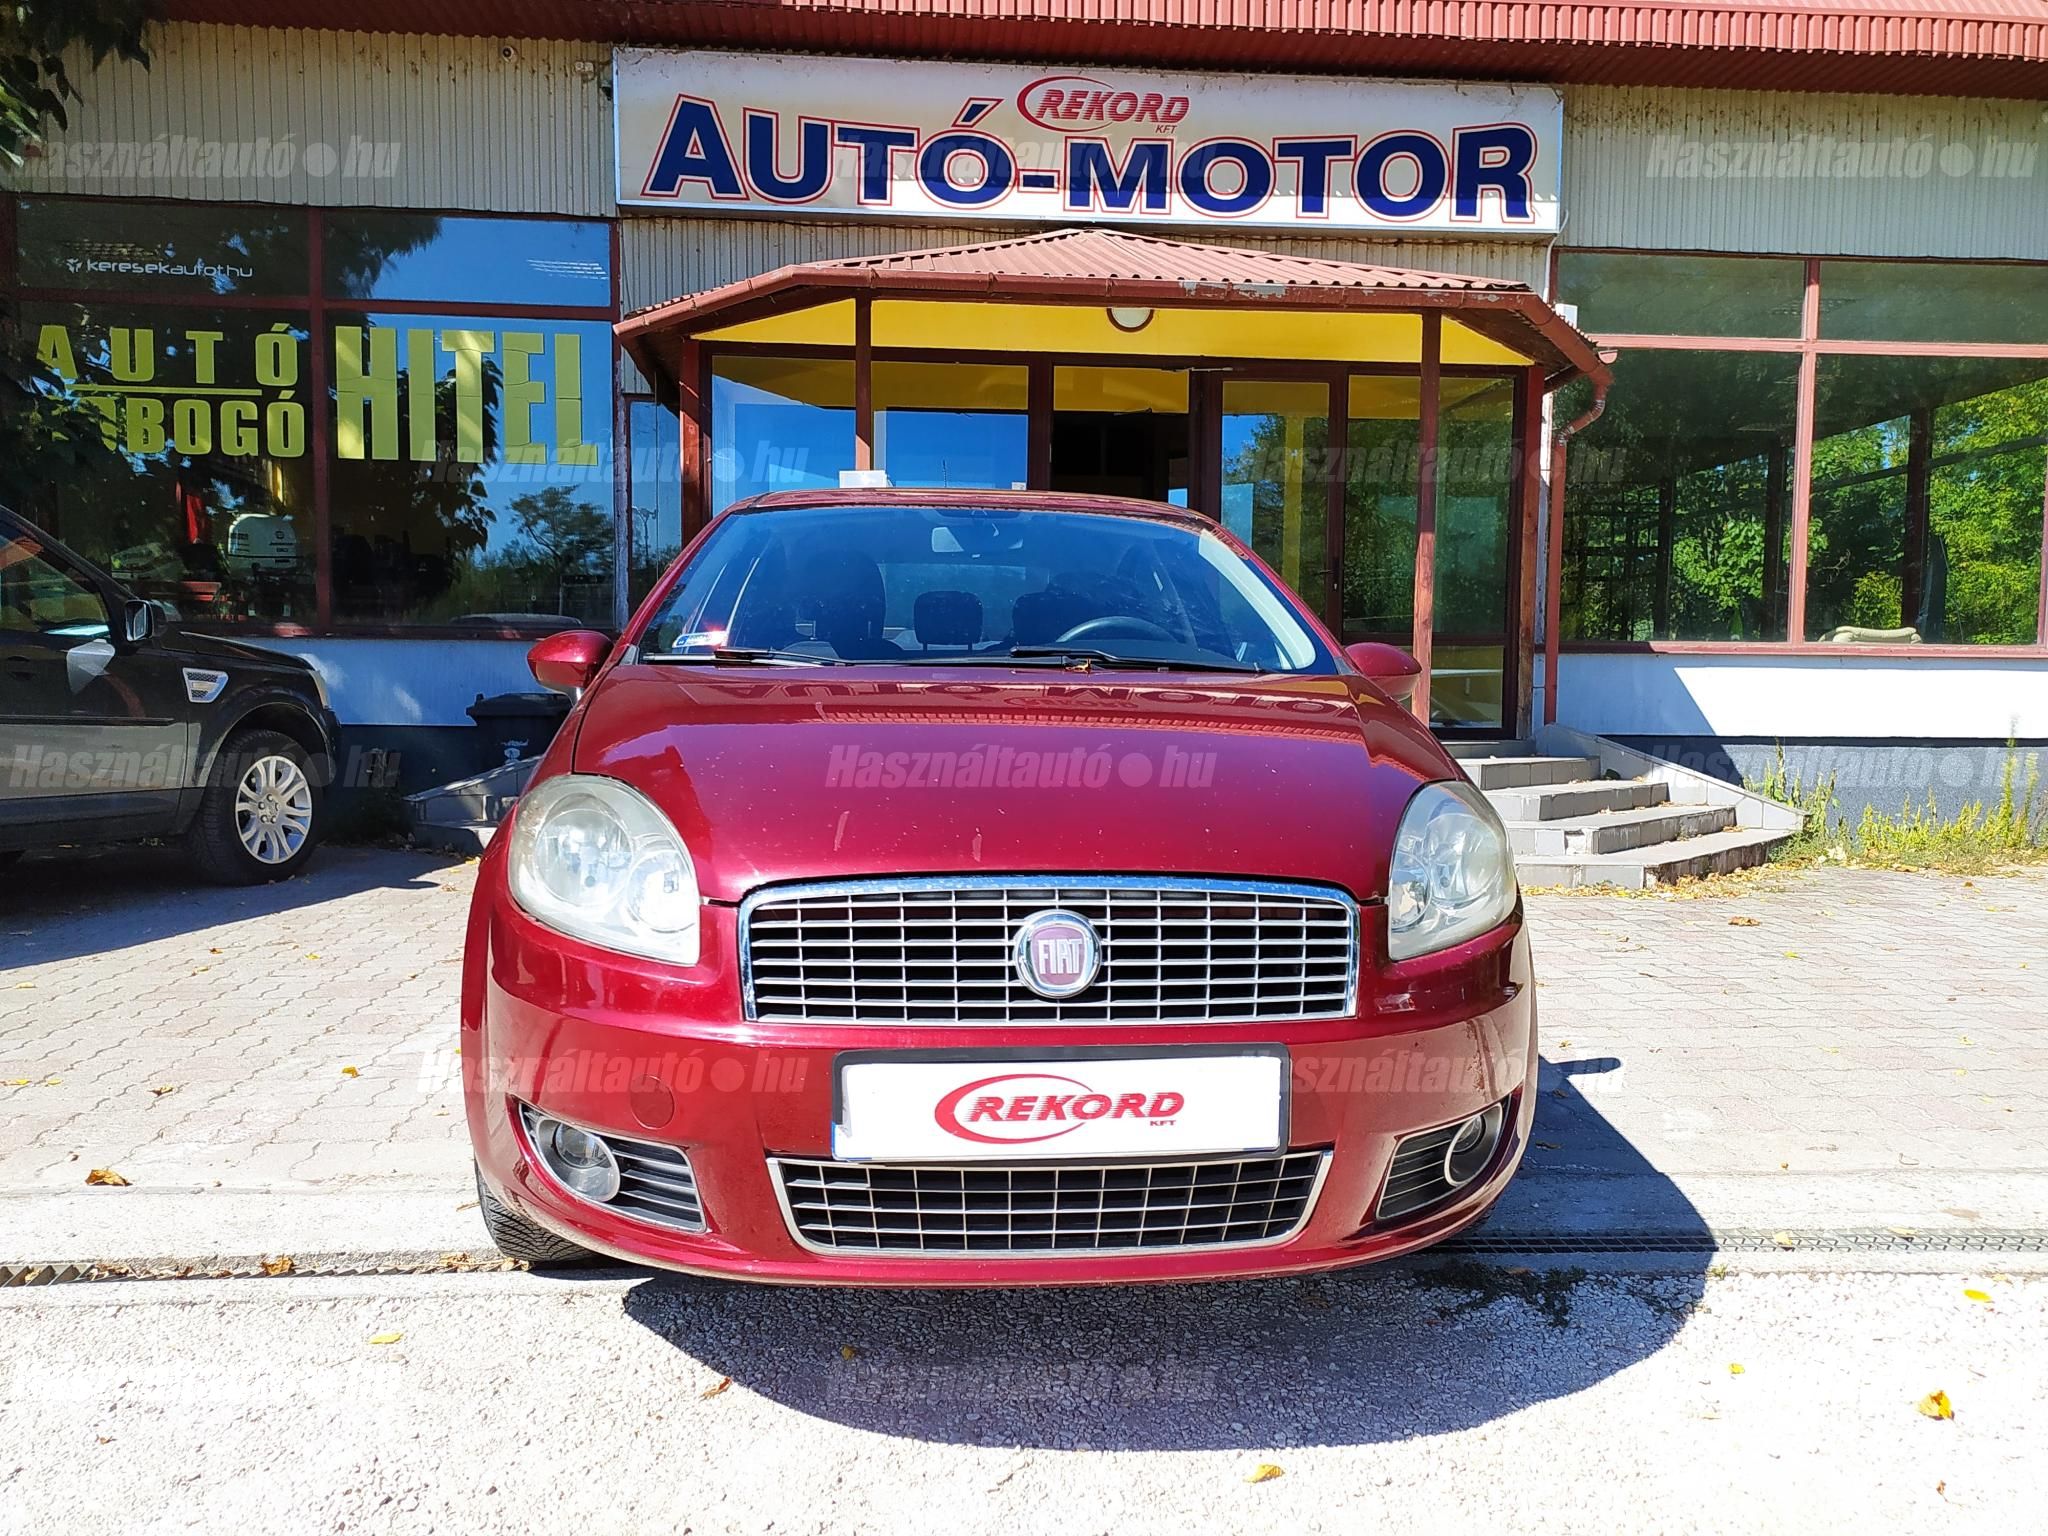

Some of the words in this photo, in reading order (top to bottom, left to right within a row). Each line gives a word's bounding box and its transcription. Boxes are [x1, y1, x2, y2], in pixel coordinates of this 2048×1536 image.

[1035, 89, 1190, 124] REKORD
[1155, 124, 1177, 134] KFT
[641, 93, 1537, 223] AUTÓ-MOTOR
[335, 326, 598, 467] HITEL
[80, 389, 305, 458] BOGÓ
[1038, 938, 1083, 975] FIAT
[965, 1092, 1185, 1122] REKORD
